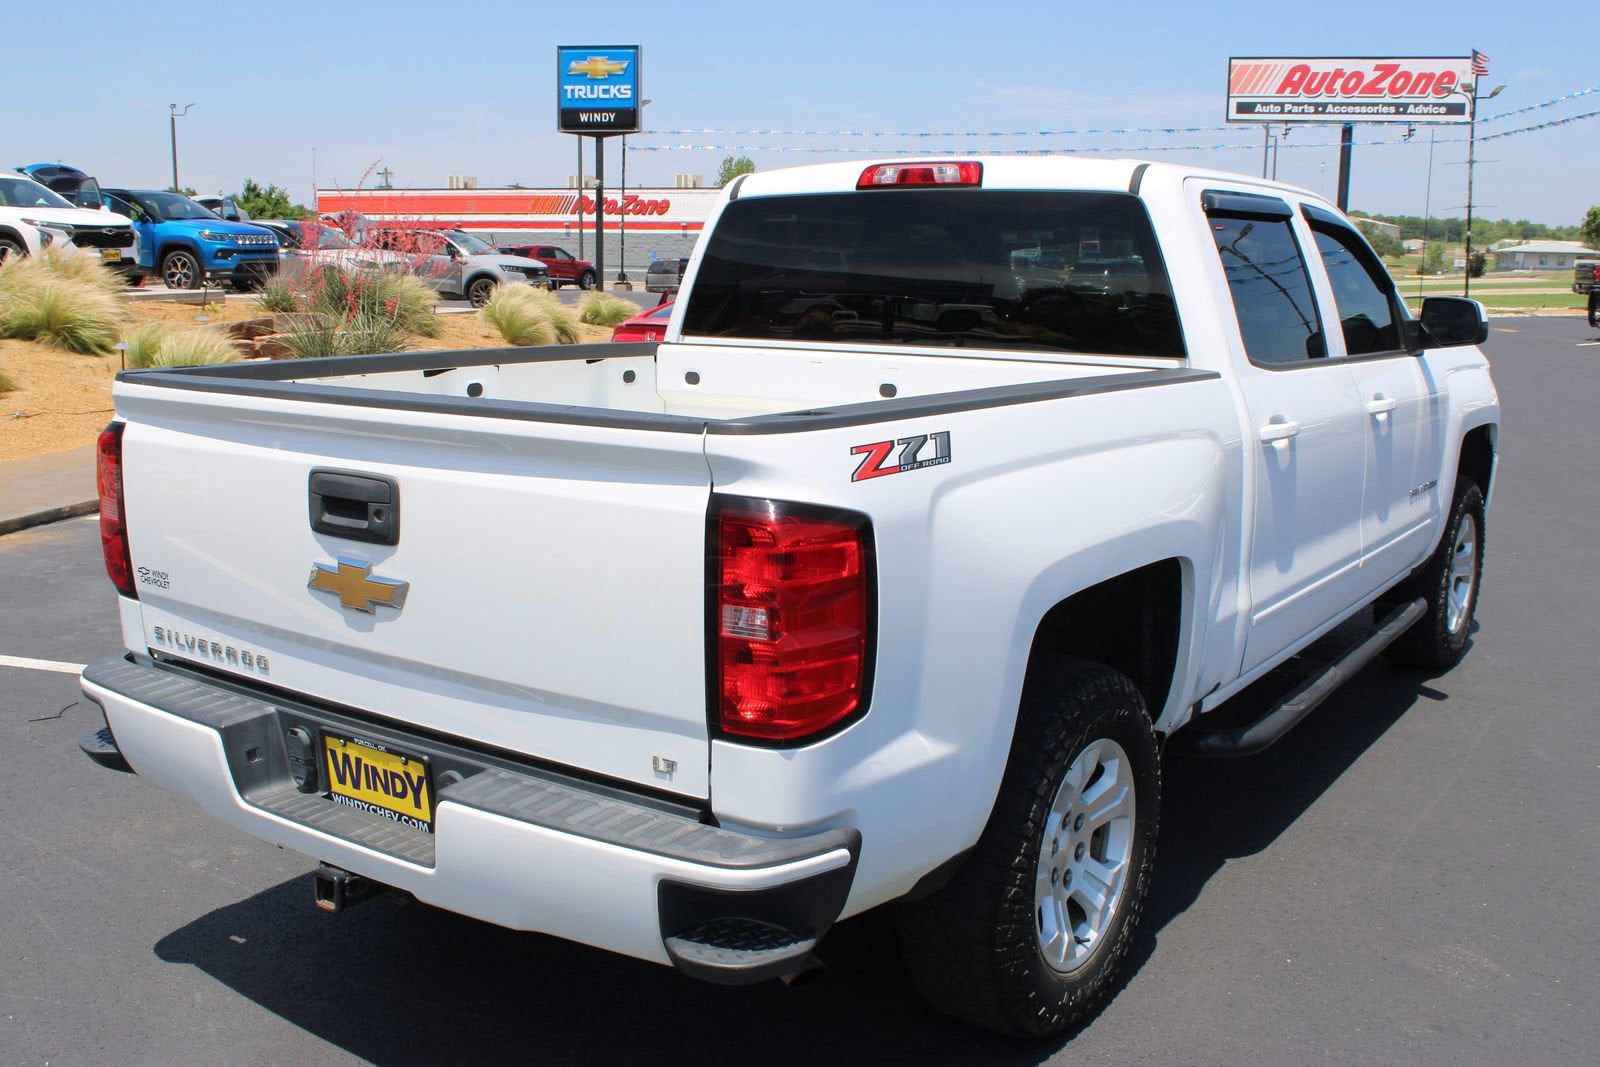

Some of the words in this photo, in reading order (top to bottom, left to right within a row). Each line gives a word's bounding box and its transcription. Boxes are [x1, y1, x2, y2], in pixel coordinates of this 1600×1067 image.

[563, 85, 632, 99] TRUCKS
[1275, 63, 1458, 98] AutoZone
[579, 112, 616, 122] WINDY
[1254, 103, 1282, 114] Auto
[1284, 103, 1315, 114] Parts
[1325, 103, 1396, 114] Accessories
[1407, 103, 1447, 114] Advice
[850, 430, 952, 483] Z71
[901, 462, 920, 471] OFF
[922, 457, 949, 467] ROAD
[154, 626, 270, 672] SILVERADO
[652, 755, 677, 775] LT
[329, 748, 426, 810] WINDY
[331, 792, 430, 833] WINDYCHEV.COM
